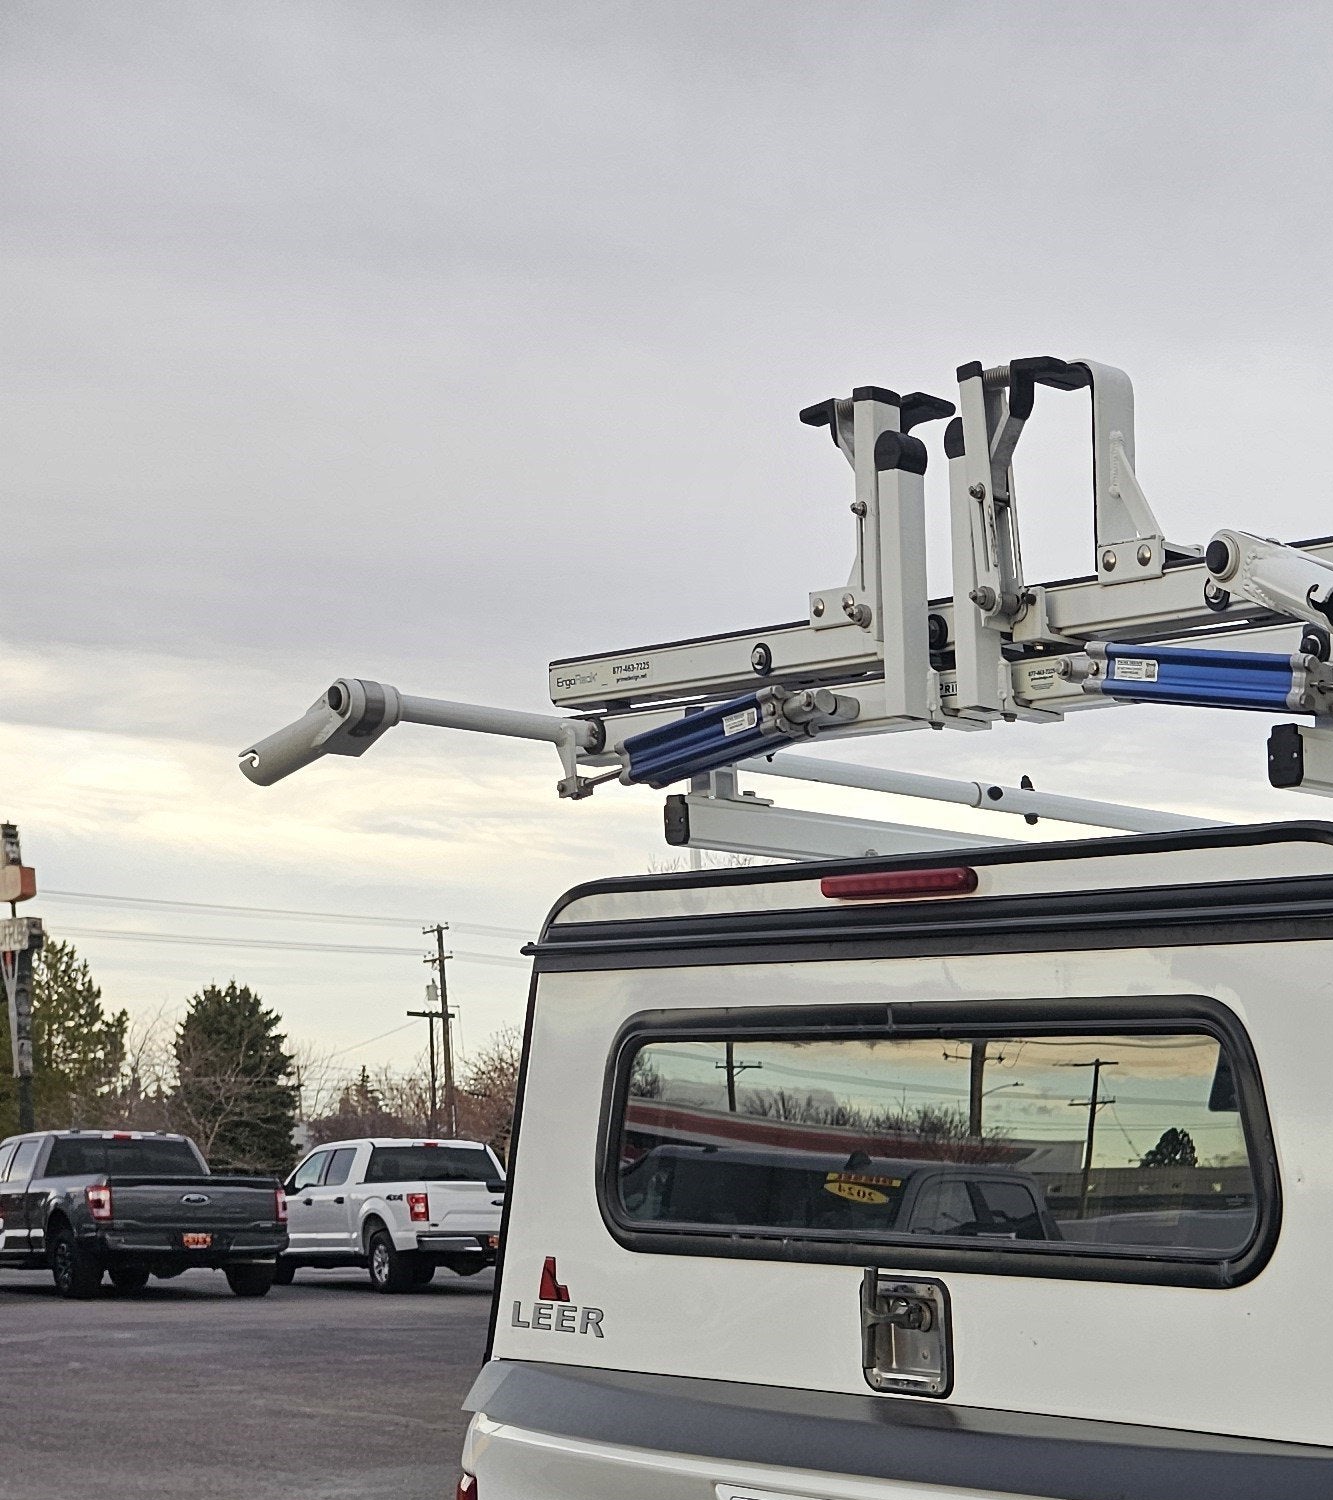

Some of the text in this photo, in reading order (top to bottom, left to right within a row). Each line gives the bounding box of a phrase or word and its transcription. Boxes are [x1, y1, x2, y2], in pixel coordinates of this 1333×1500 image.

[612, 662, 650, 675] 877-463-7225
[940, 683, 958, 694] PRI
[511, 1301, 604, 1338] LEER
